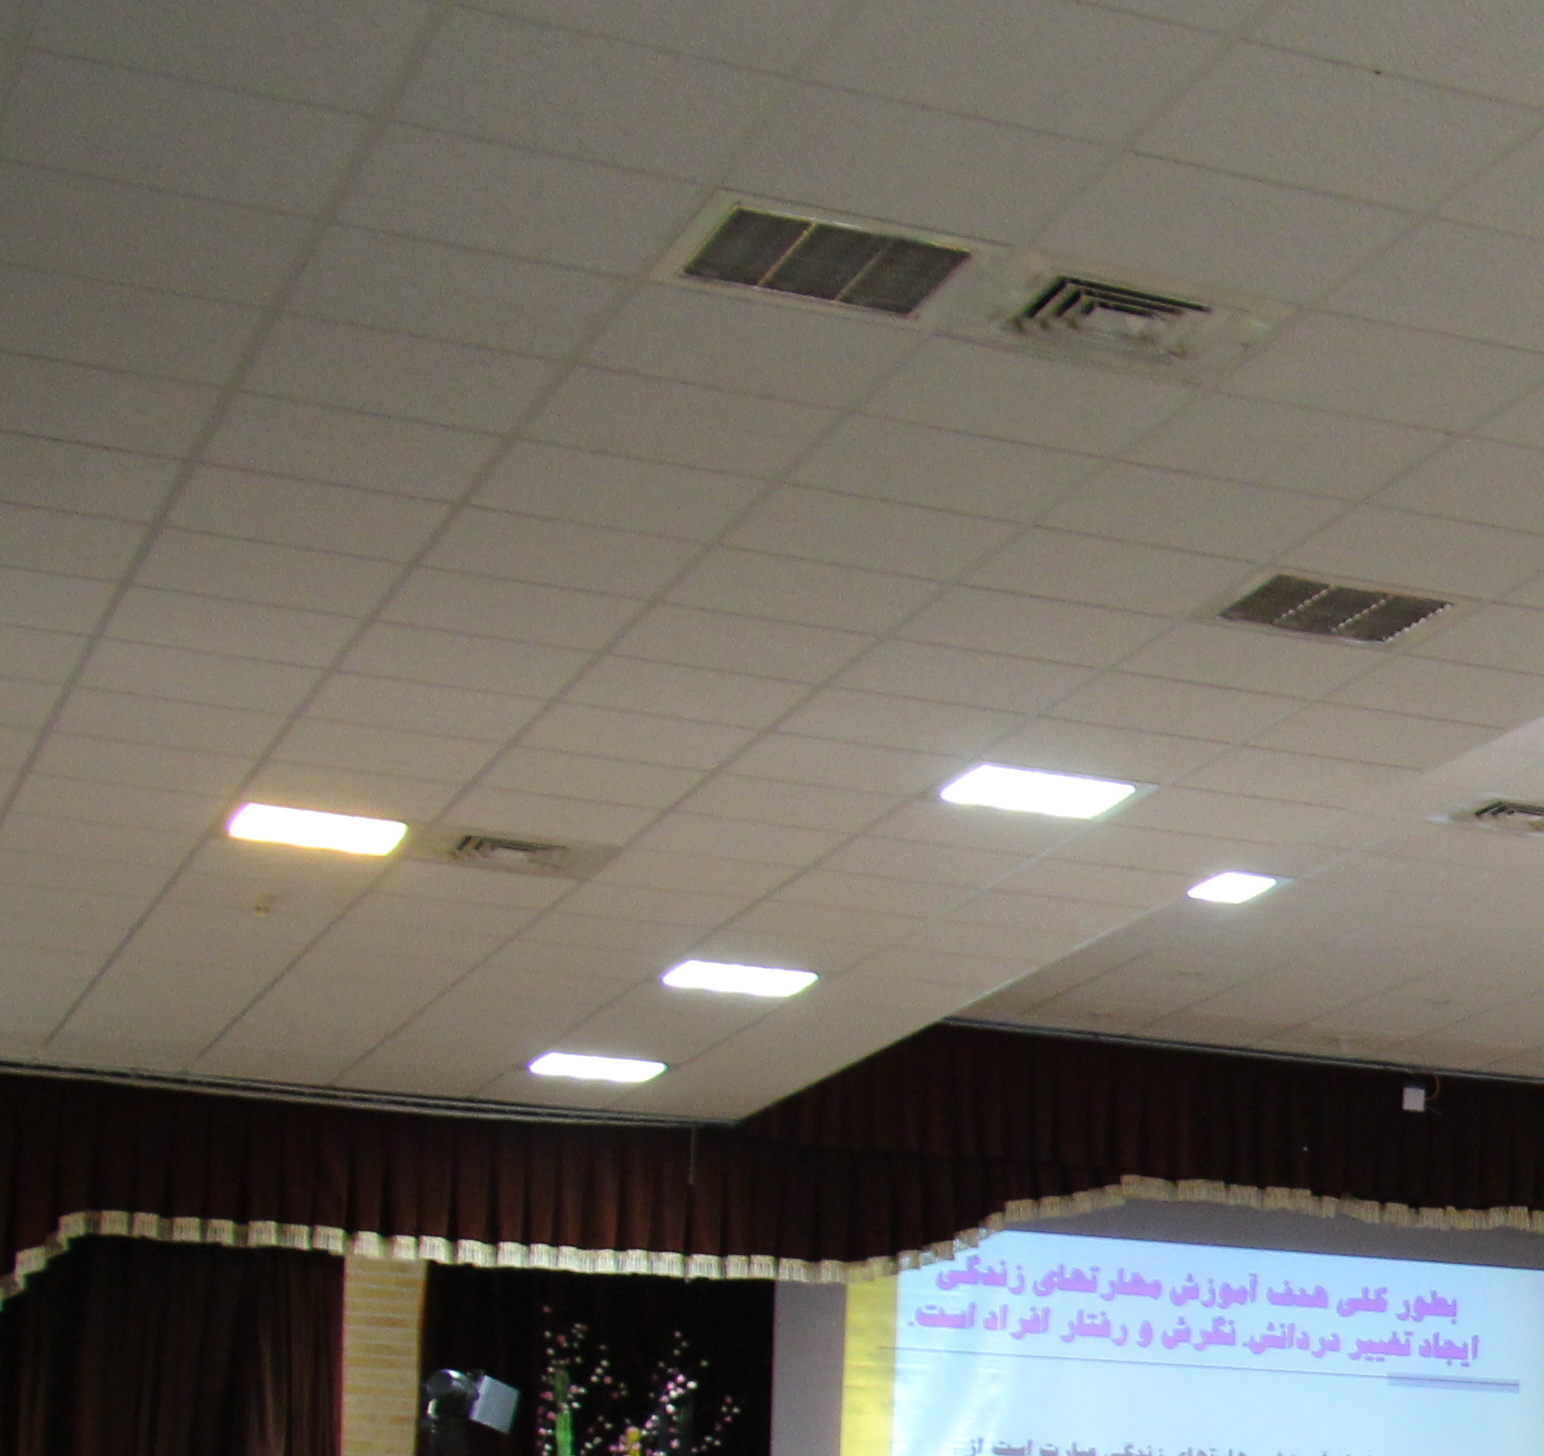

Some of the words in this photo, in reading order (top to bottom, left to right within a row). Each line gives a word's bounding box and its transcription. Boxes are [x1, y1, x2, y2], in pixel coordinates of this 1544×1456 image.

[935, 1255, 1026, 1295] زندگی
[1169, 1272, 1258, 1310] آموزش
[1266, 1279, 1329, 1308] هدف
[1336, 1286, 1388, 1317] کلی
[1396, 1290, 1458, 1325] بطور
[1060, 1308, 1128, 1347] رفتار
[1137, 1320, 1153, 1348] و
[1161, 1315, 1237, 1351] نگرش
[1348, 1330, 1414, 1362] تغییر
[1418, 1332, 1479, 1367] ایجاد
[992, 1438, 1033, 1456] است
